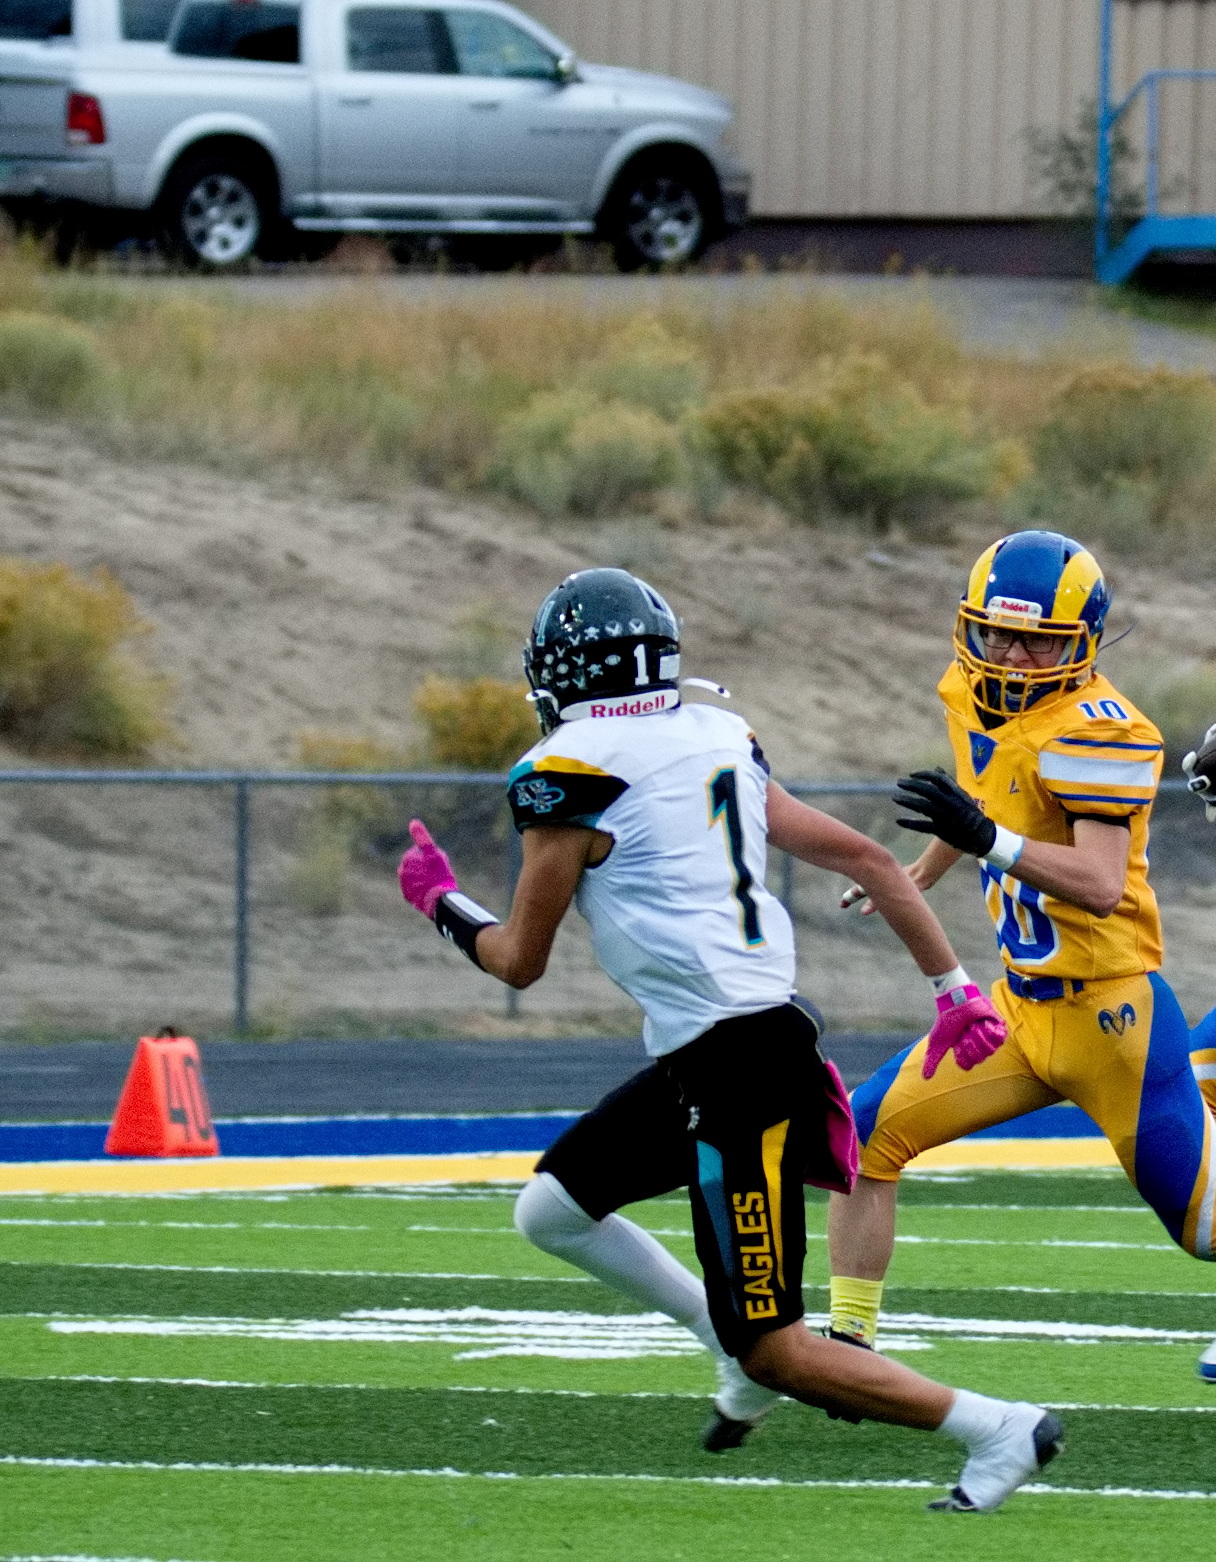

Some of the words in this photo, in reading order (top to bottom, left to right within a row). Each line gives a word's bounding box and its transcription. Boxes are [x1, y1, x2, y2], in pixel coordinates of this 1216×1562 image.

[633, 644, 649, 686] 1
[590, 695, 666, 718] Riddell
[1078, 699, 1129, 720] 10
[705, 764, 768, 950] 1
[732, 1191, 779, 1320] EAGLES
